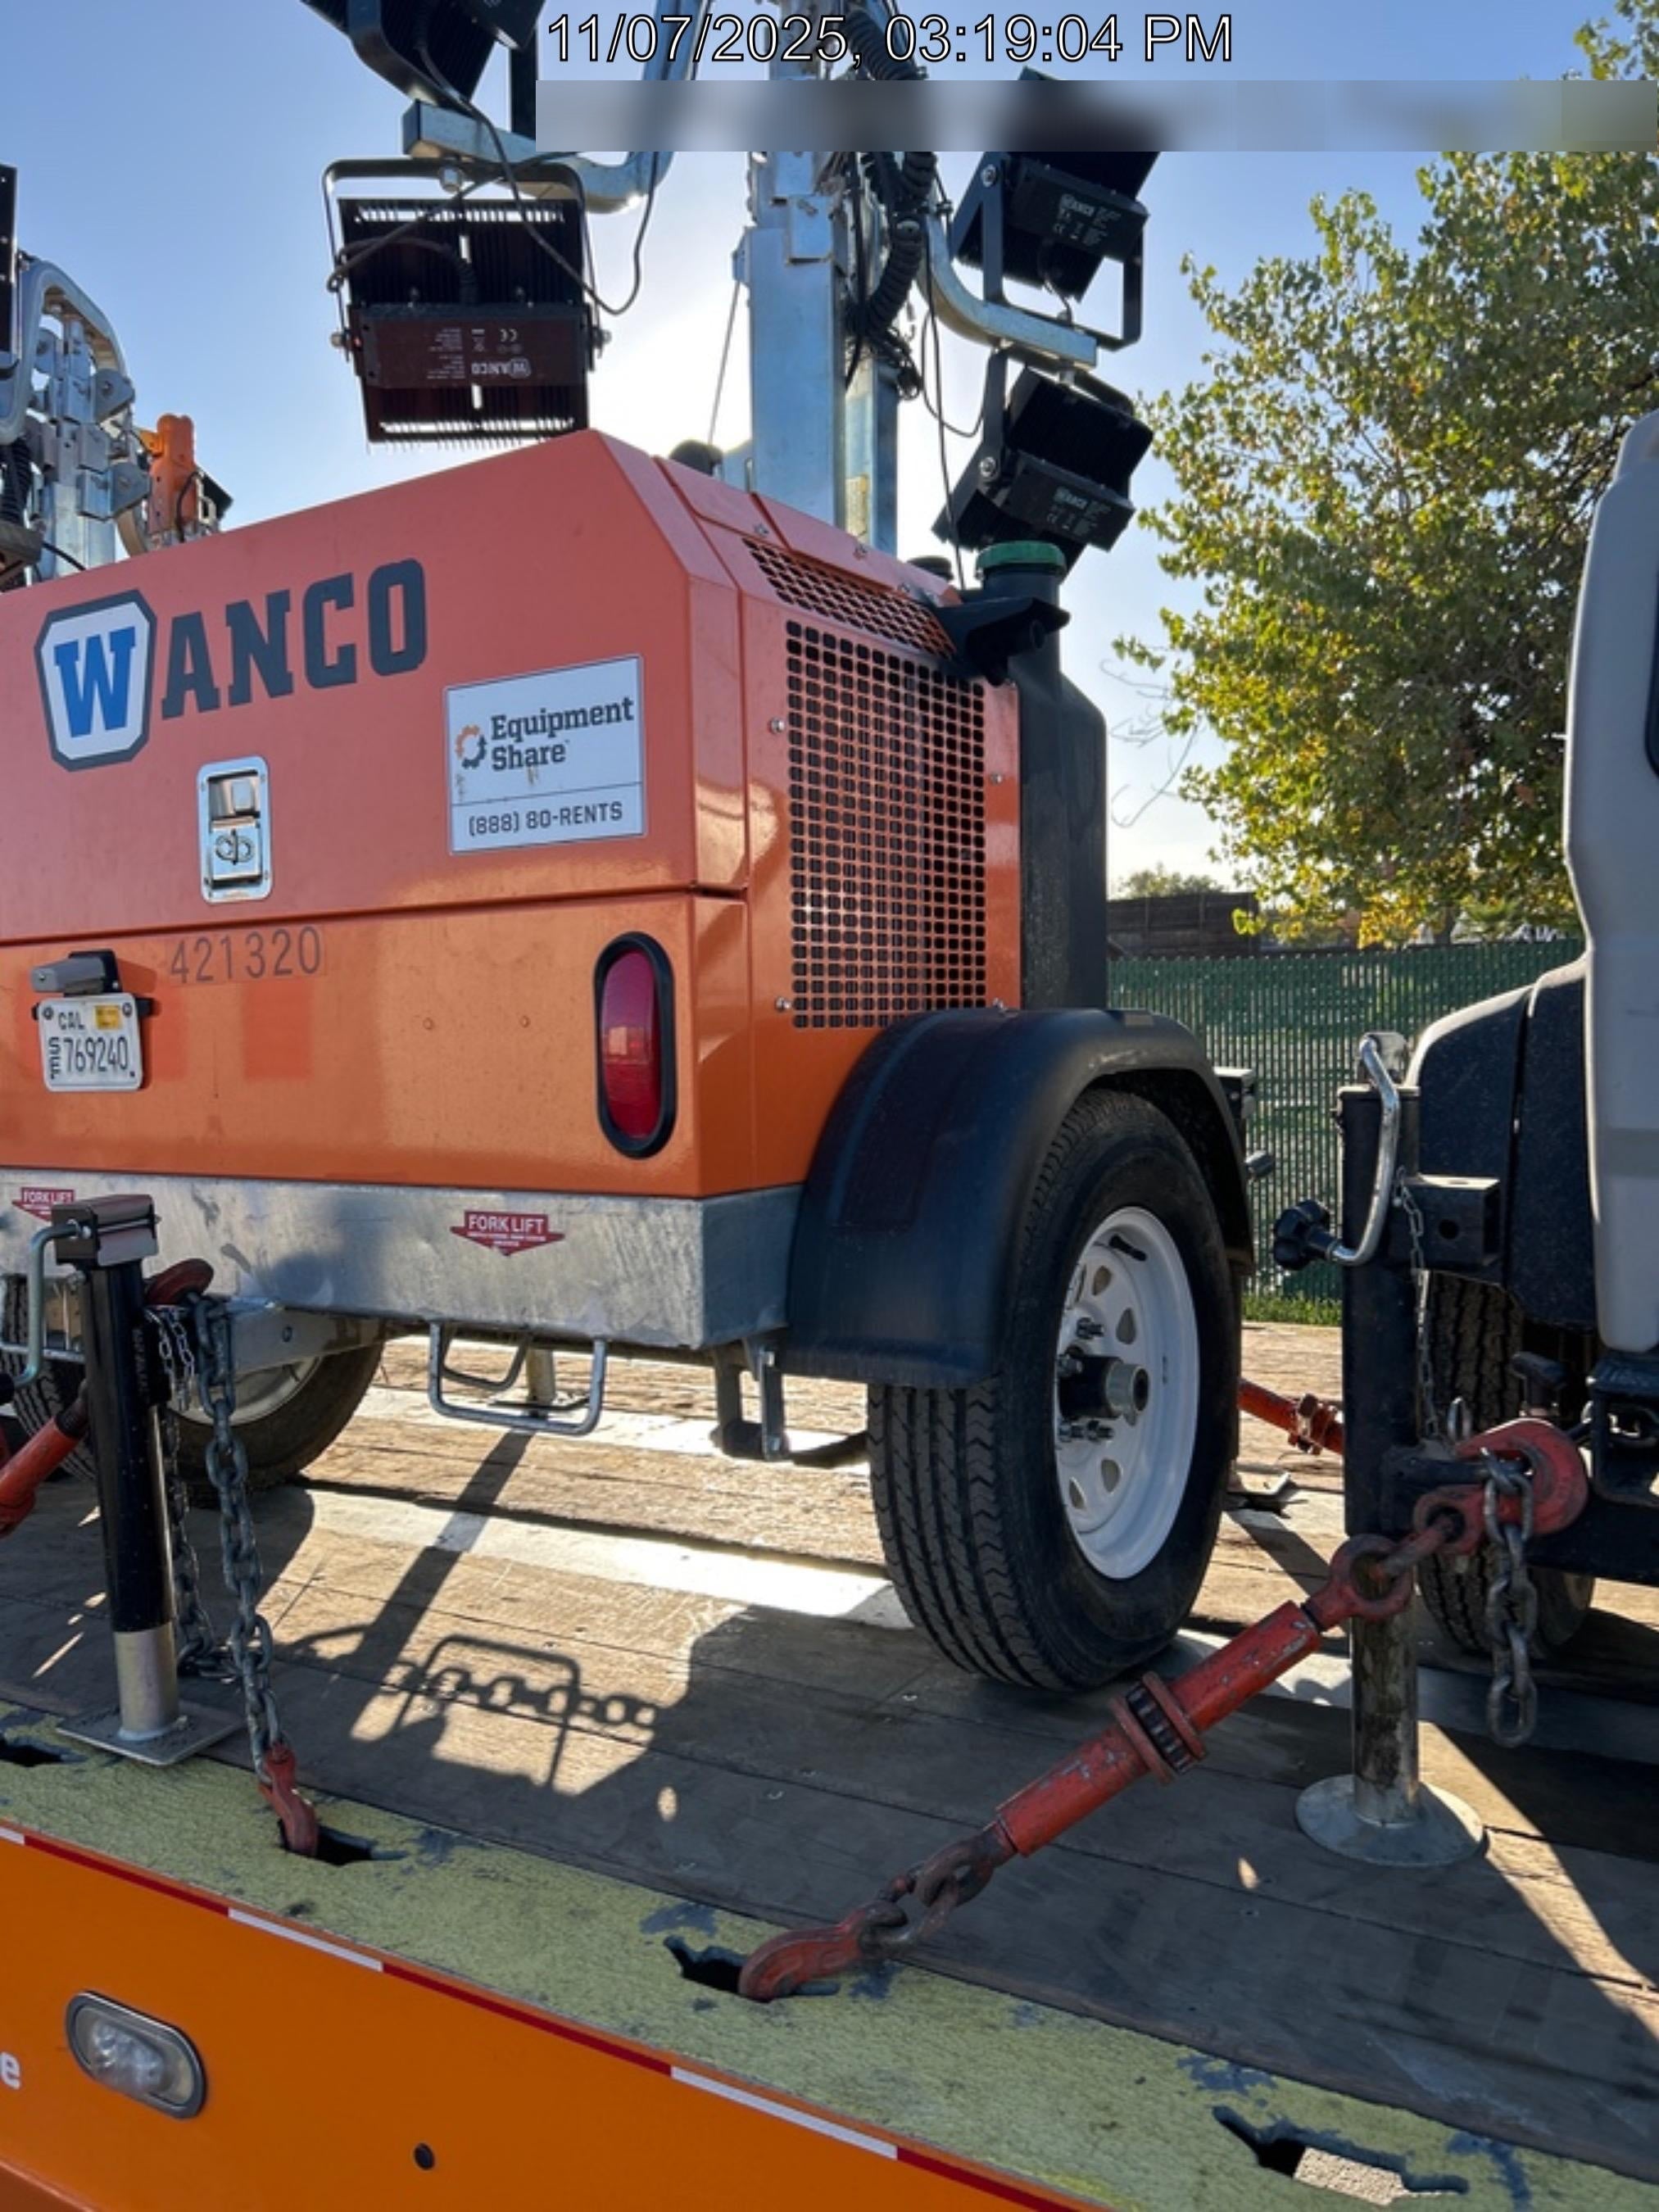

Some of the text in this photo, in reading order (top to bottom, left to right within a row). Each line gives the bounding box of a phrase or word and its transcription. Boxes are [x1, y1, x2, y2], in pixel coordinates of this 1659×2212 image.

[54, 558, 427, 739] WANCO
[492, 697, 634, 743] Equipment
[492, 744, 566, 772] Share
[469, 801, 623, 836] (888) 80-RENTS
[171, 926, 321, 984] 421320
[57, 1012, 85, 1031] CAL
[64, 1036, 129, 1072] 769240
[469, 1214, 544, 1233] FORK LIFT
